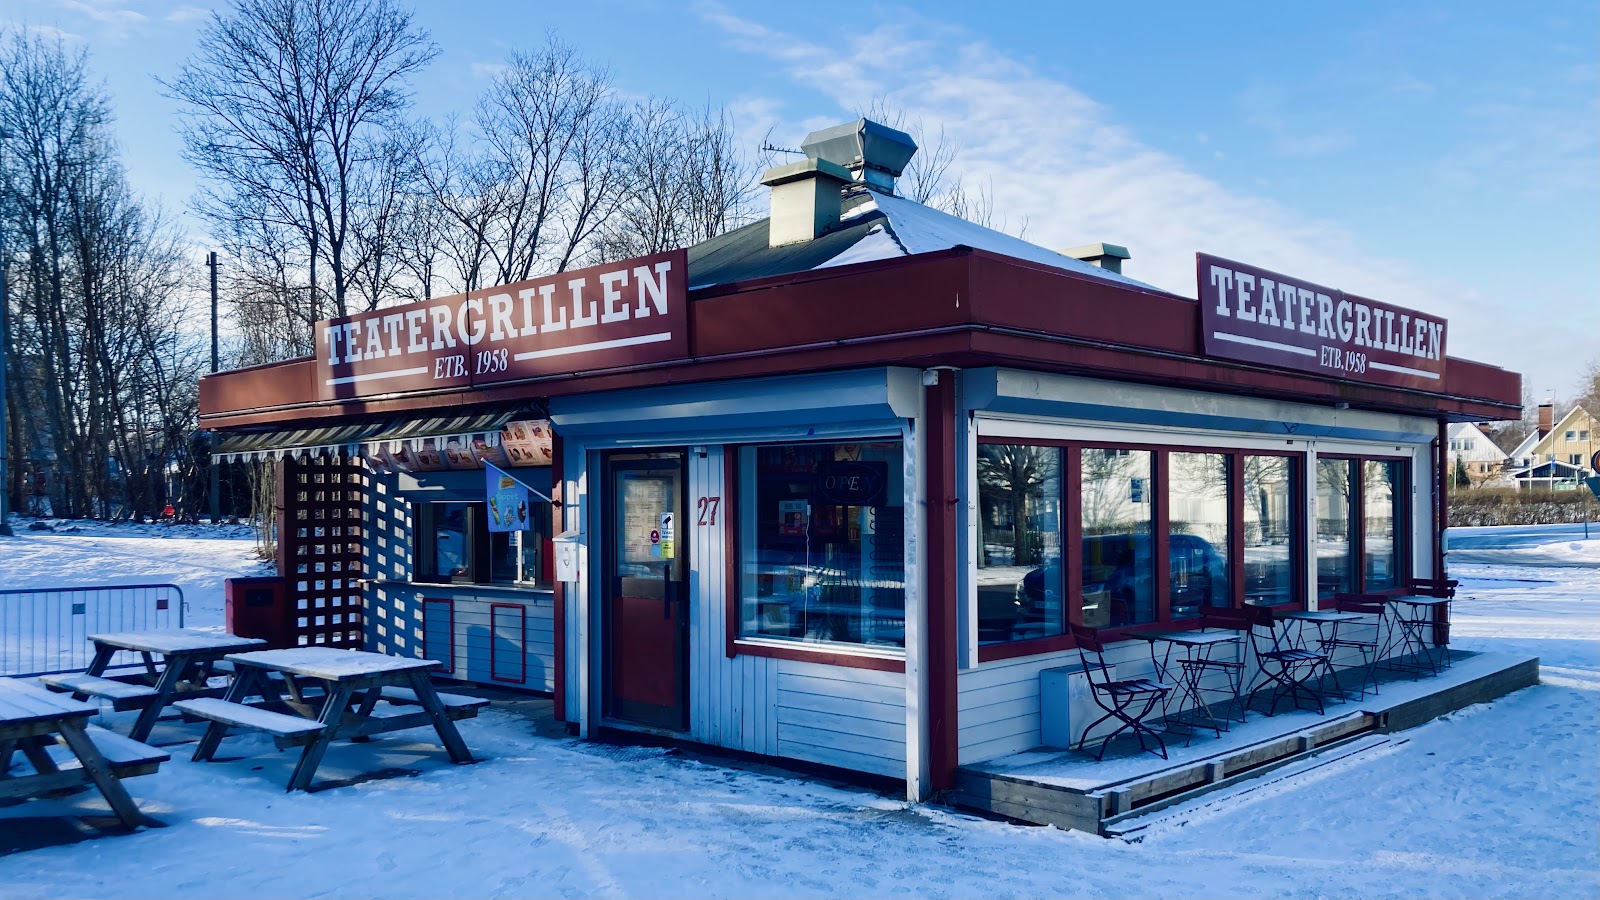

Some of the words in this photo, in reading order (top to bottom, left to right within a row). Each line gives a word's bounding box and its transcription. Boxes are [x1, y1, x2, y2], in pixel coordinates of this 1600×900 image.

[324, 261, 672, 366] TEATERGRILLEN
[1210, 265, 1443, 361] TEATERGRILLEN
[433, 354, 469, 380] ETB.
[475, 348, 508, 375] 1958
[697, 496, 720, 526] 27
